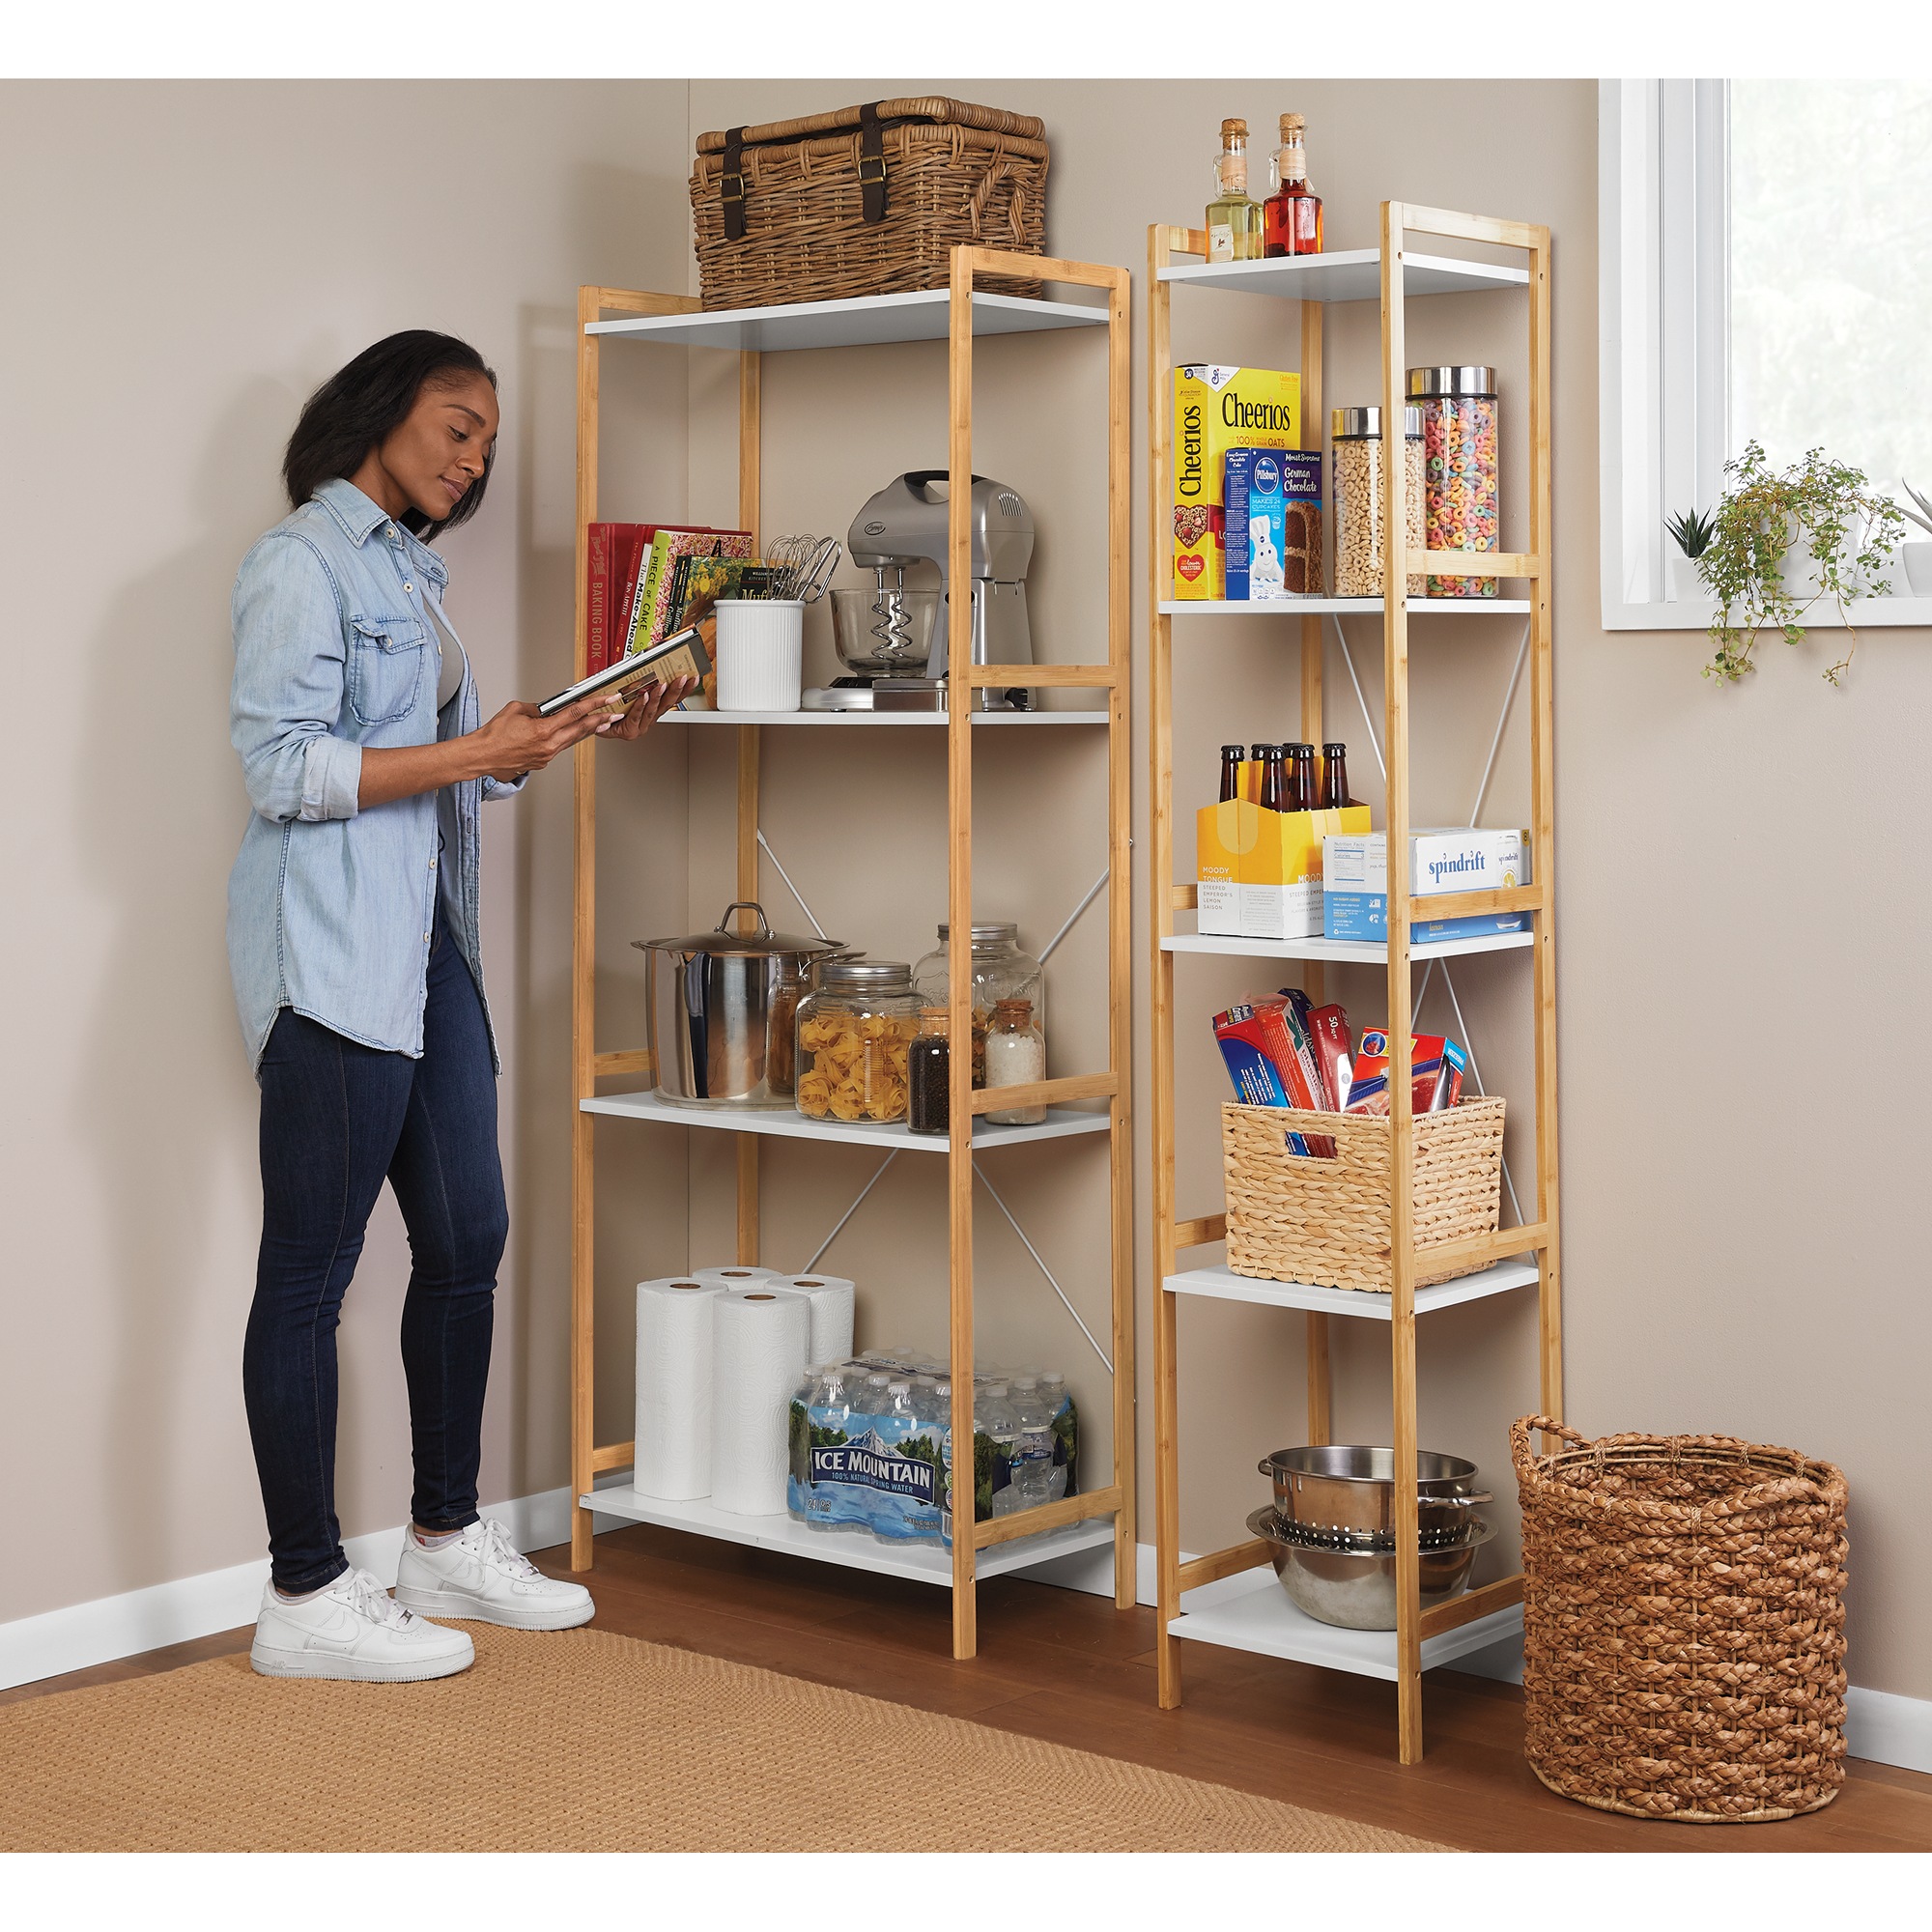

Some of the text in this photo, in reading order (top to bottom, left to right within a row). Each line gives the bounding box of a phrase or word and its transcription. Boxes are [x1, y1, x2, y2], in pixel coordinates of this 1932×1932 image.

[1222, 392, 1291, 431] Cheerios
[1179, 405, 1201, 497] Cheerios
[1236, 436, 1255, 446] 100%
[1267, 438, 1285, 447] OATS
[1285, 453, 1321, 462] Moist Supreme
[1257, 469, 1277, 483] Pillsbury
[1284, 467, 1311, 479] German
[1284, 478, 1318, 493] Chocolate
[639, 562, 647, 581] The
[648, 555, 659, 585] PIECE
[592, 582, 603, 624] BAKING
[626, 582, 644, 653] Make-Ahead
[639, 603, 651, 631] CAKE
[665, 606, 674, 634] Grilling
[673, 606, 683, 633] Muffins
[591, 627, 602, 658] BOOK
[1429, 850, 1485, 884] spindrift
[1498, 852, 1519, 865] spindrift
[1328, 1015, 1339, 1028] 50
[814, 1451, 844, 1470] ICE
[847, 1451, 930, 1489] MOUNTAIN
[832, 1471, 914, 1493] 100% NATURAL SPRING WATER
[808, 1497, 816, 1511] 24
